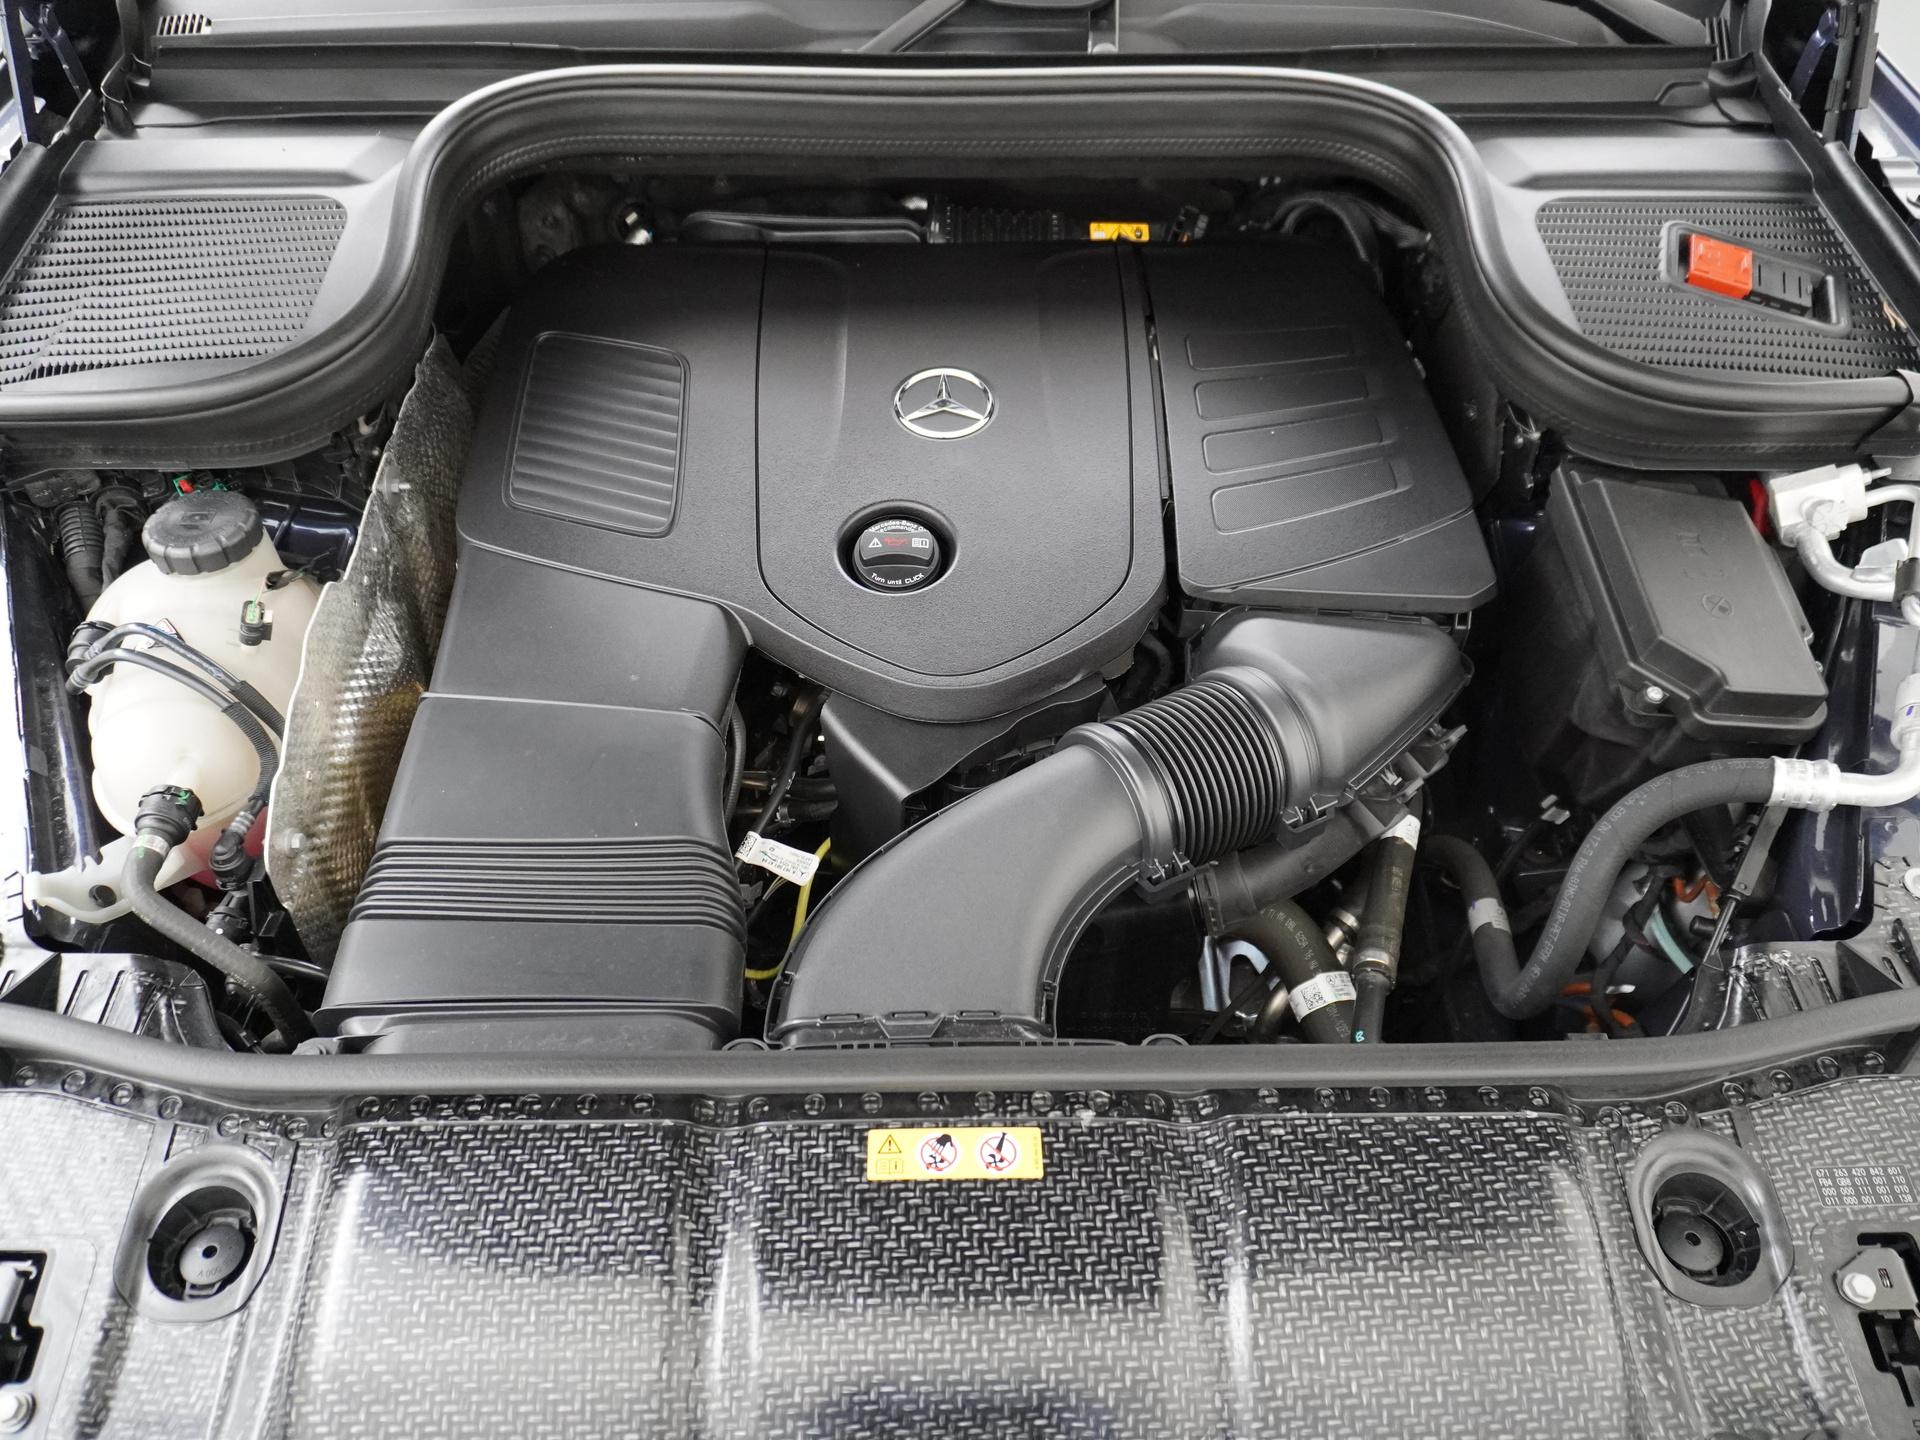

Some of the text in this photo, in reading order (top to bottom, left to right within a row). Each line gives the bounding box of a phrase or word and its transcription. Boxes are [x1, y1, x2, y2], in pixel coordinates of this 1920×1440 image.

[871, 573, 885, 583] Turn
[904, 573, 925, 584] CLICK
[1816, 1169, 1829, 1177] 671
[1852, 1168, 1866, 1176] 420
[1855, 1177, 1869, 1185] 011
[1840, 1187, 1855, 1195] 000
[1876, 1186, 1890, 1194] 001
[1894, 1185, 1909, 1193] 010
[1825, 1197, 1840, 1205] 011
[1899, 1194, 1913, 1202] 138
